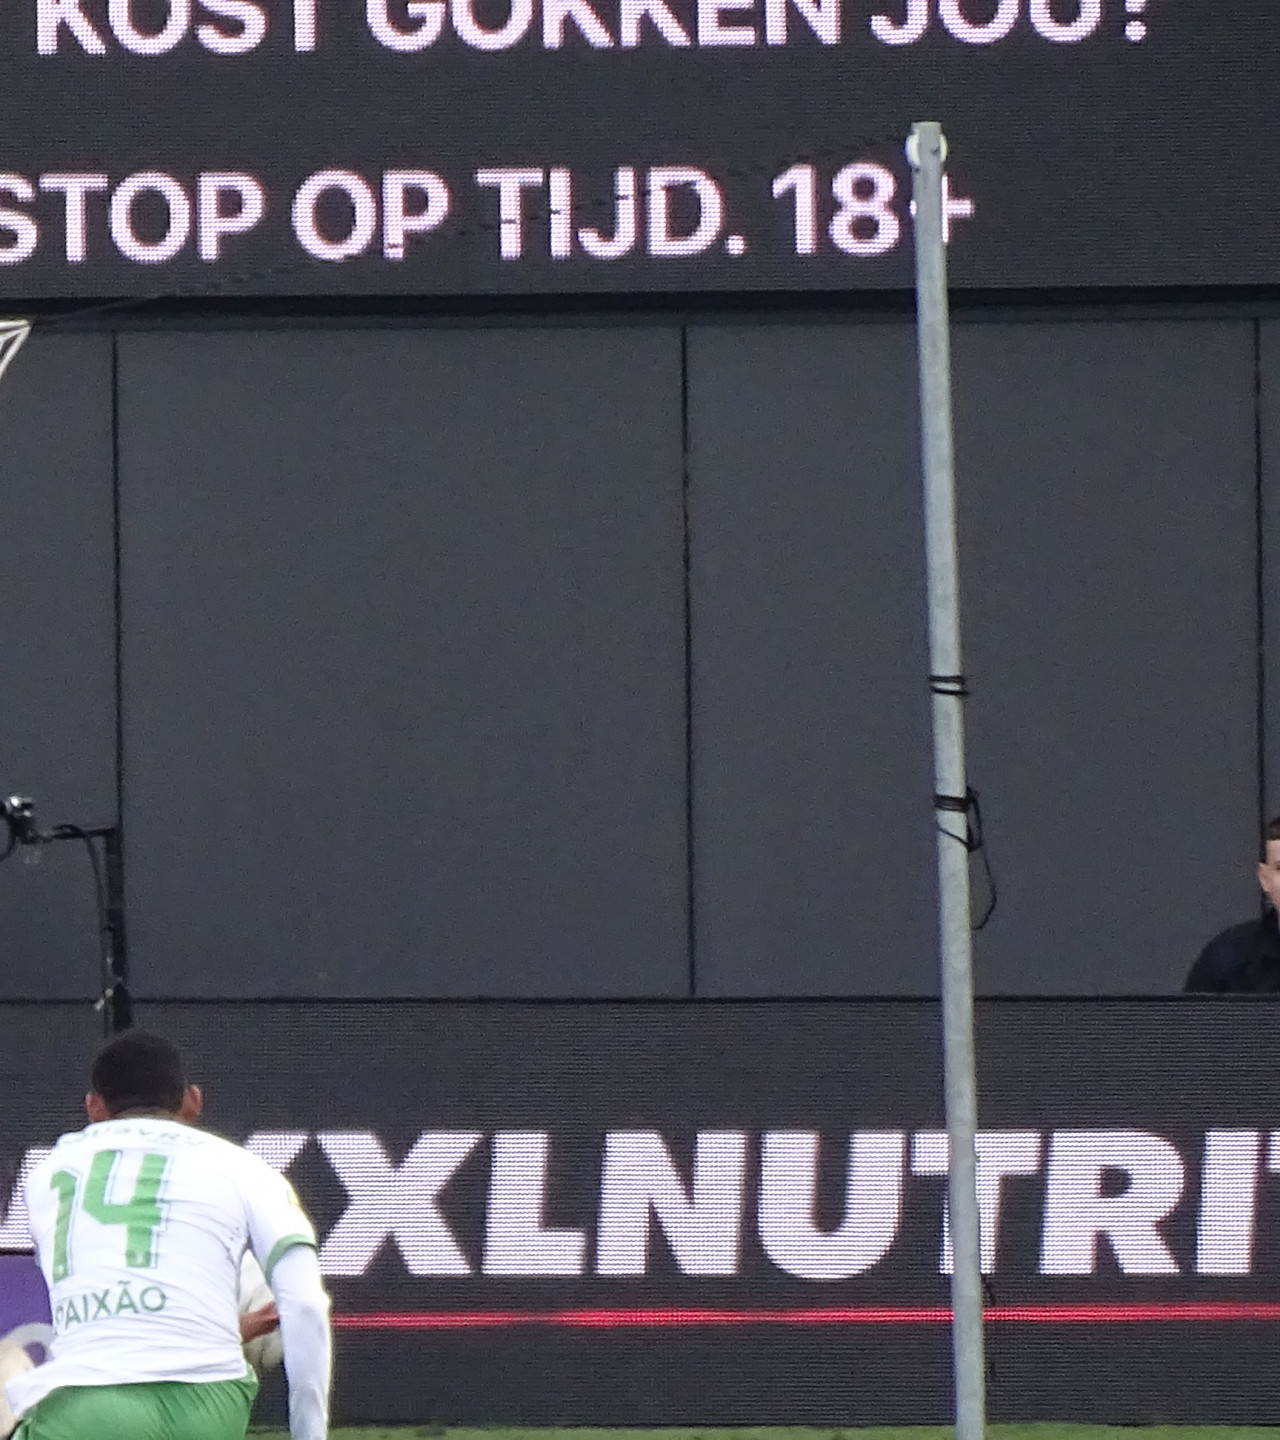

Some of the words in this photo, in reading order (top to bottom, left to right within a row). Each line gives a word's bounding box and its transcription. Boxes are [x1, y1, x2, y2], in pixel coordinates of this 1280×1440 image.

[291, 168, 451, 262] OP
[474, 166, 747, 259] TIJD.
[50, 1150, 170, 1282] 14
